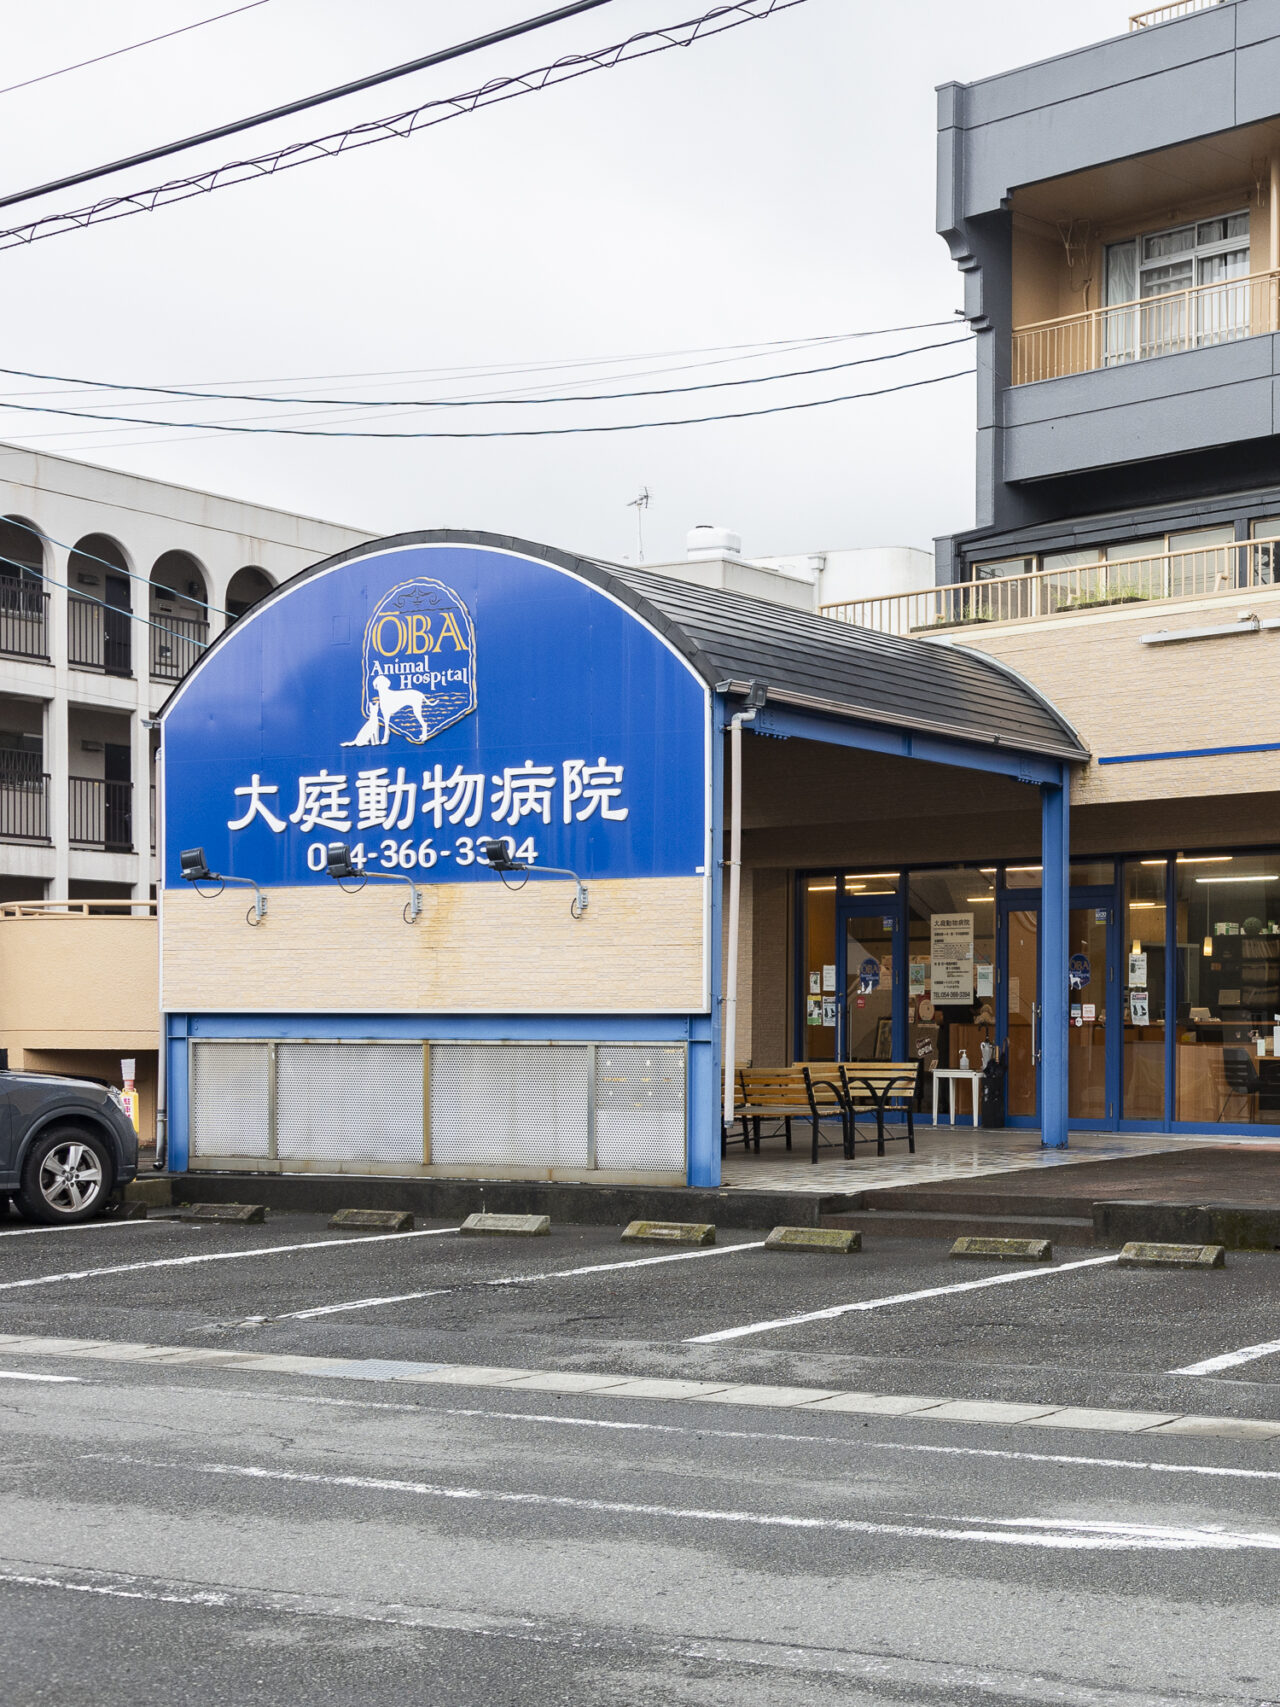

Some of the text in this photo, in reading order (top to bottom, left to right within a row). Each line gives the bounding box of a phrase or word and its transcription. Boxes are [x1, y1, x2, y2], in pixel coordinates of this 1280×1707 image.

[371, 655, 430, 676] Animal
[400, 668, 469, 690] Hospital
[227, 757, 630, 832] 大庭動物病院
[307, 835, 539, 872] 04-366-334
[917, 1043, 933, 1056] OPEN
